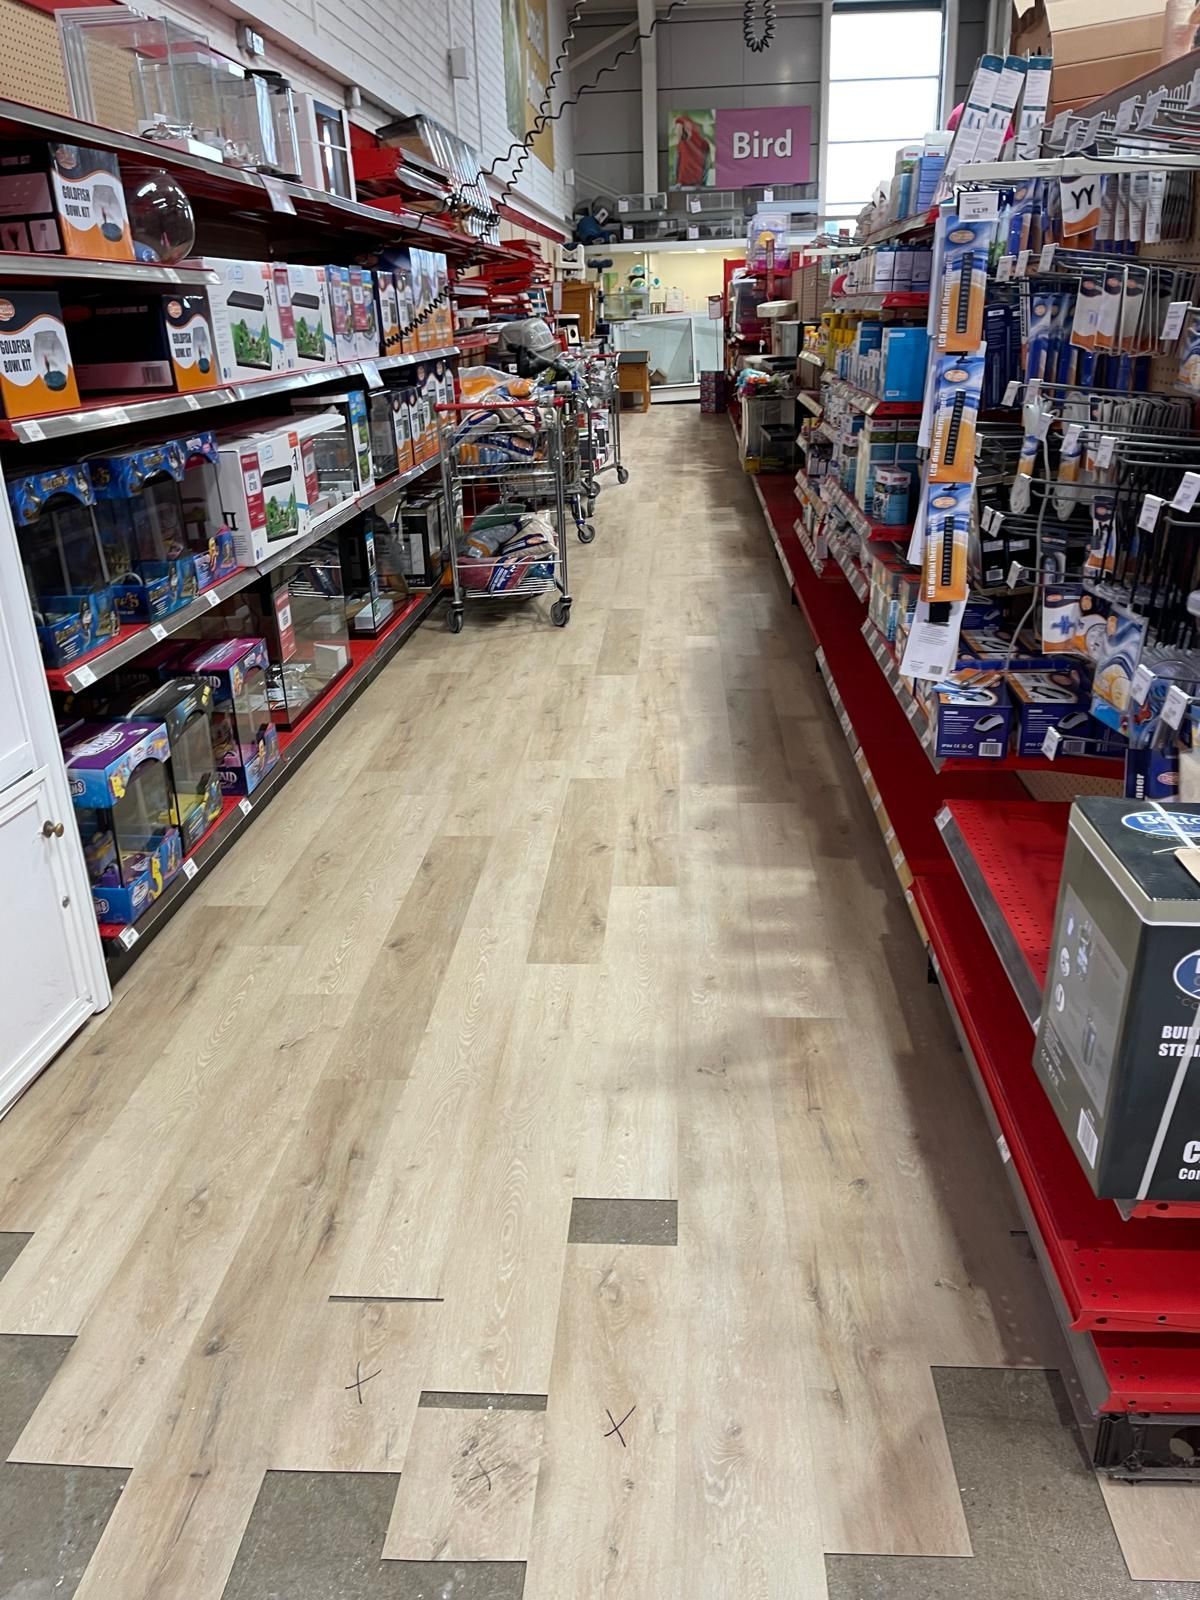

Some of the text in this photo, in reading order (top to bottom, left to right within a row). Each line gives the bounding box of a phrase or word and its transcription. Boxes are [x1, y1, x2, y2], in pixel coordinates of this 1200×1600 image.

[733, 128, 792, 160] Bird
[61, 184, 91, 202] GOLDFISH
[1070, 184, 1095, 210] YY
[64, 203, 91, 219] BOWL KIT
[939, 306, 950, 332] digital
[0, 338, 32, 355] GOLDFISH
[3, 358, 32, 374] BOWL KIT
[931, 439, 941, 462] digital
[929, 463, 939, 477] LCD
